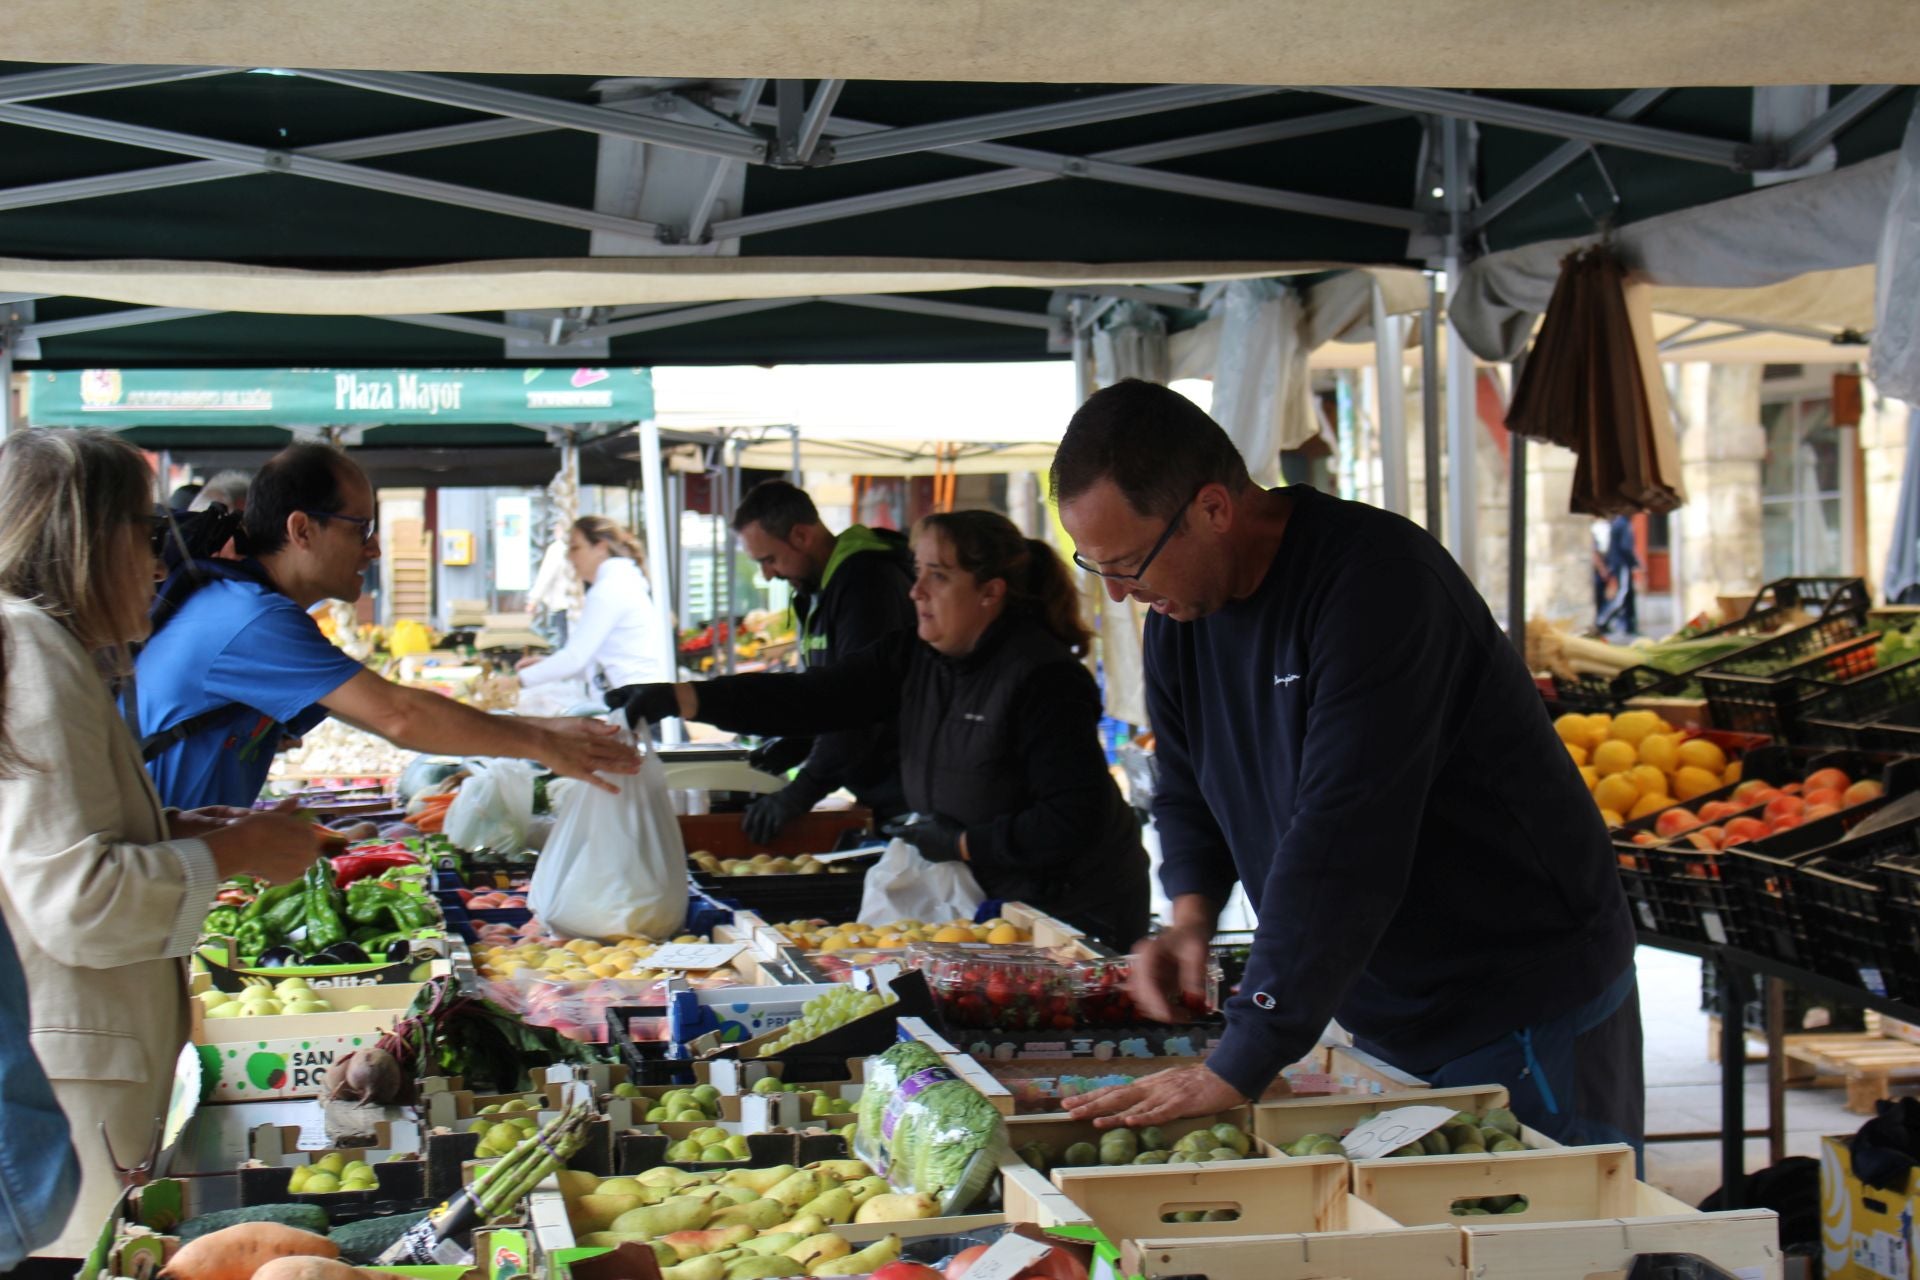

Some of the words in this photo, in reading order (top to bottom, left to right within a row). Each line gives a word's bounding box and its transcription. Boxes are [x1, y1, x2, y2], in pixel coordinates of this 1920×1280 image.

[335, 374, 394, 410] Plaza
[398, 374, 463, 415] Mayor
[293, 1050, 334, 1067] SAN
[294, 1068, 329, 1087] RO
